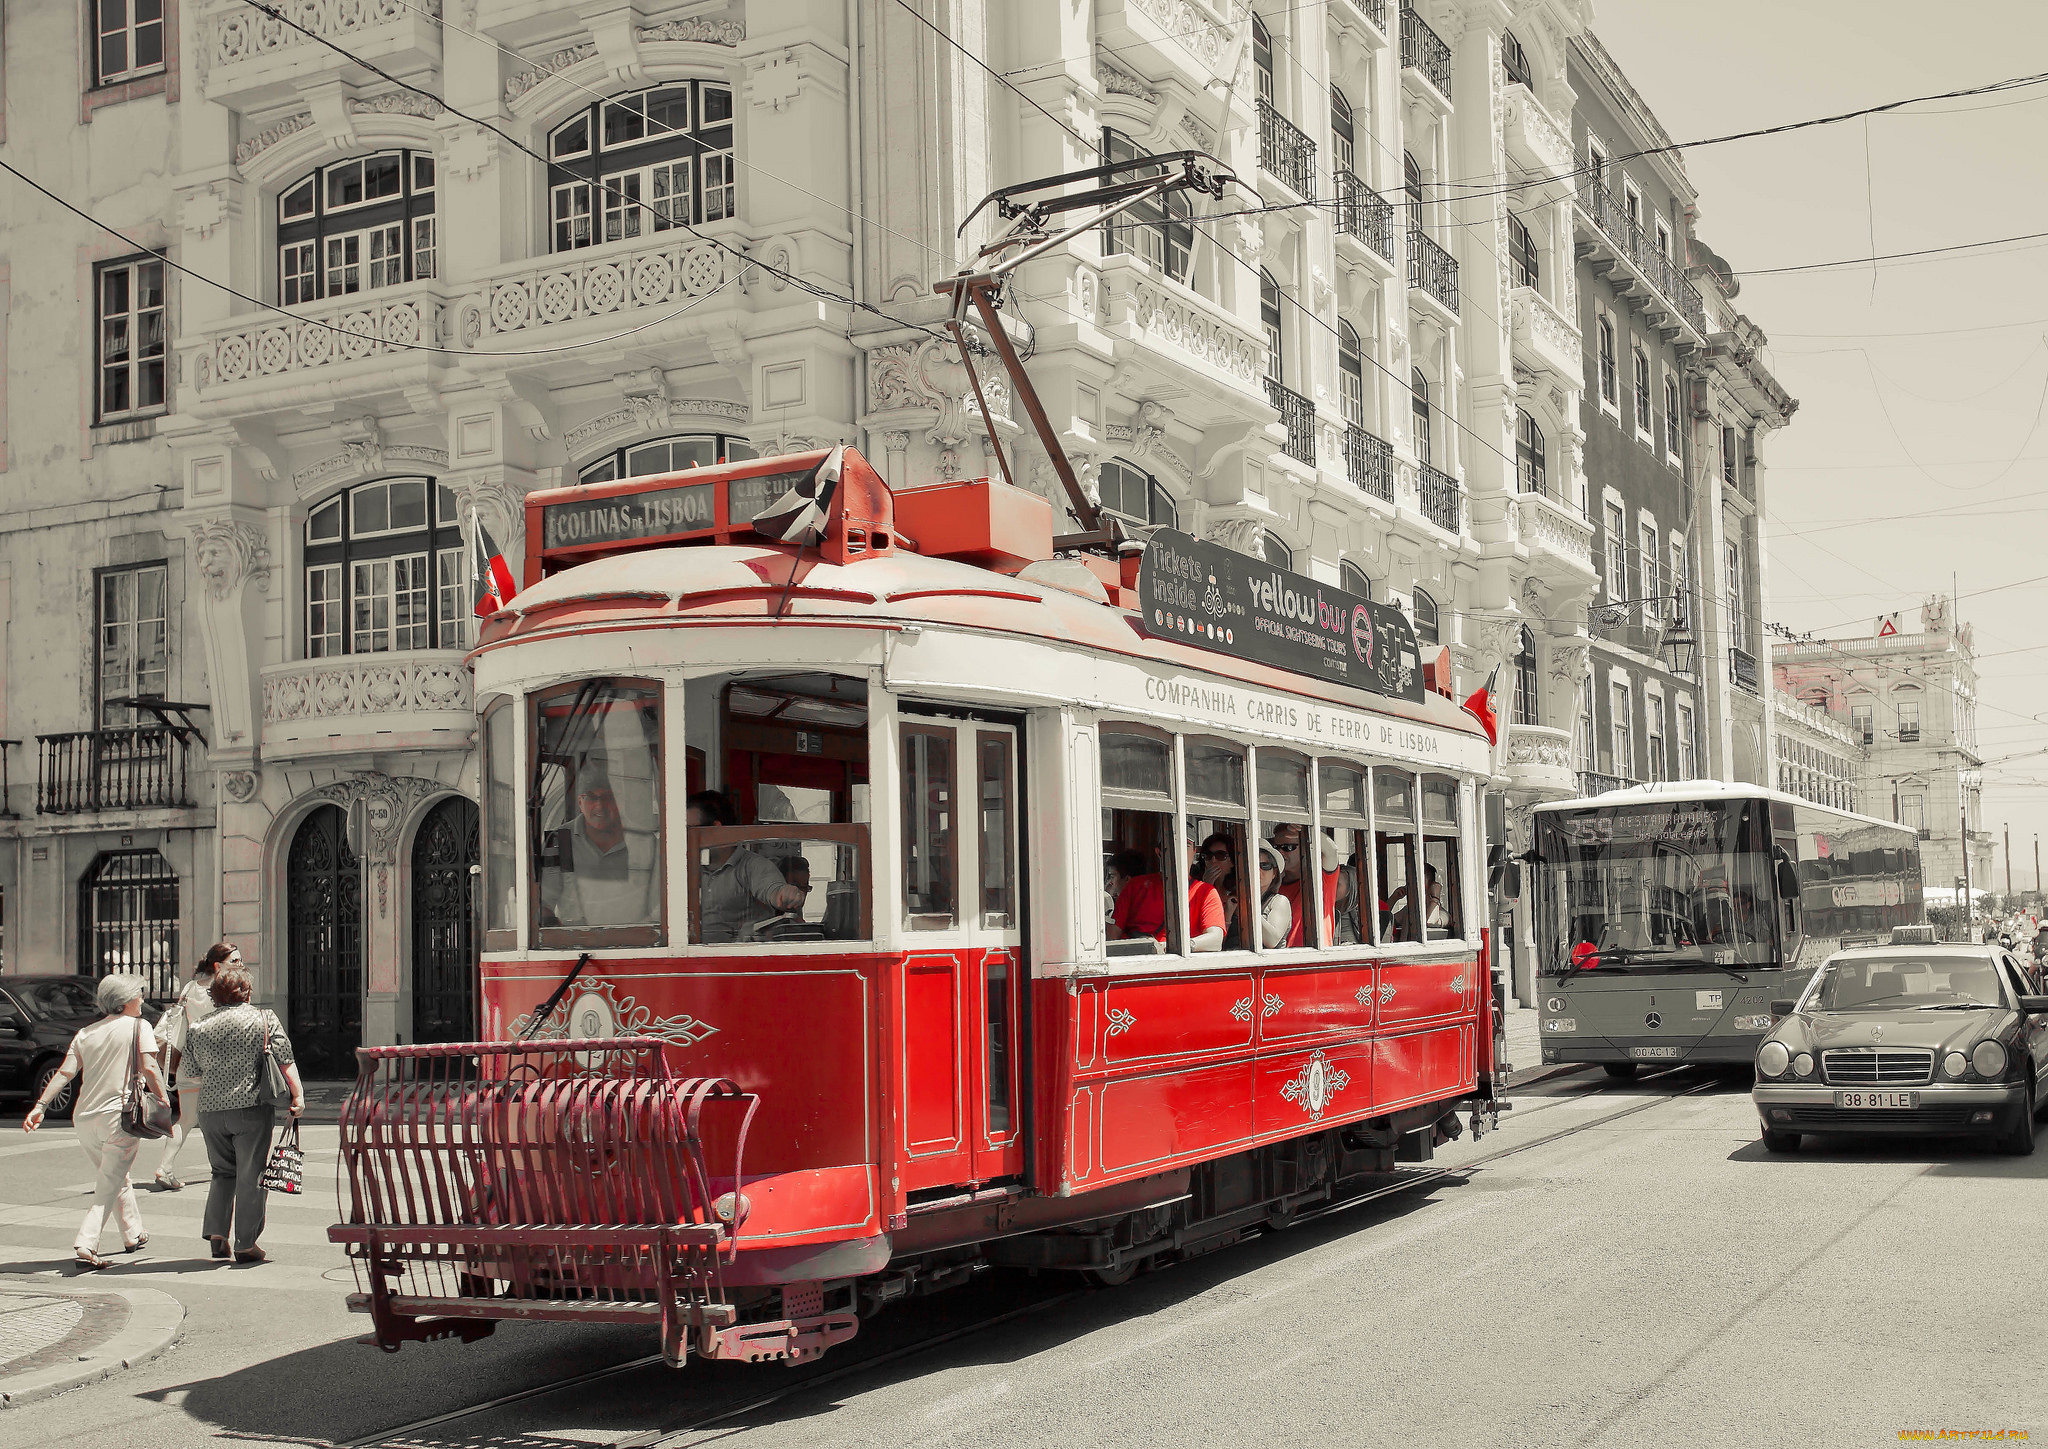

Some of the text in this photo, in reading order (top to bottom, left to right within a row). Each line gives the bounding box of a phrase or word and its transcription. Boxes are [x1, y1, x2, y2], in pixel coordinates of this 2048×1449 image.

[736, 478, 799, 498] CIRCUIT
[557, 504, 632, 542] COLINAS
[643, 493, 707, 528] LISBOA
[1150, 540, 1202, 583] Tickets
[1152, 570, 1197, 611] inside
[1254, 615, 1347, 657] OFFICIAL SIGHTSEEING TOURS
[1145, 676, 1439, 754] COMPANHIA CARRIS DE FERRO DE LISBOA
[1566, 817, 1613, 844] 759
[1901, 929, 1921, 938] TAXI
